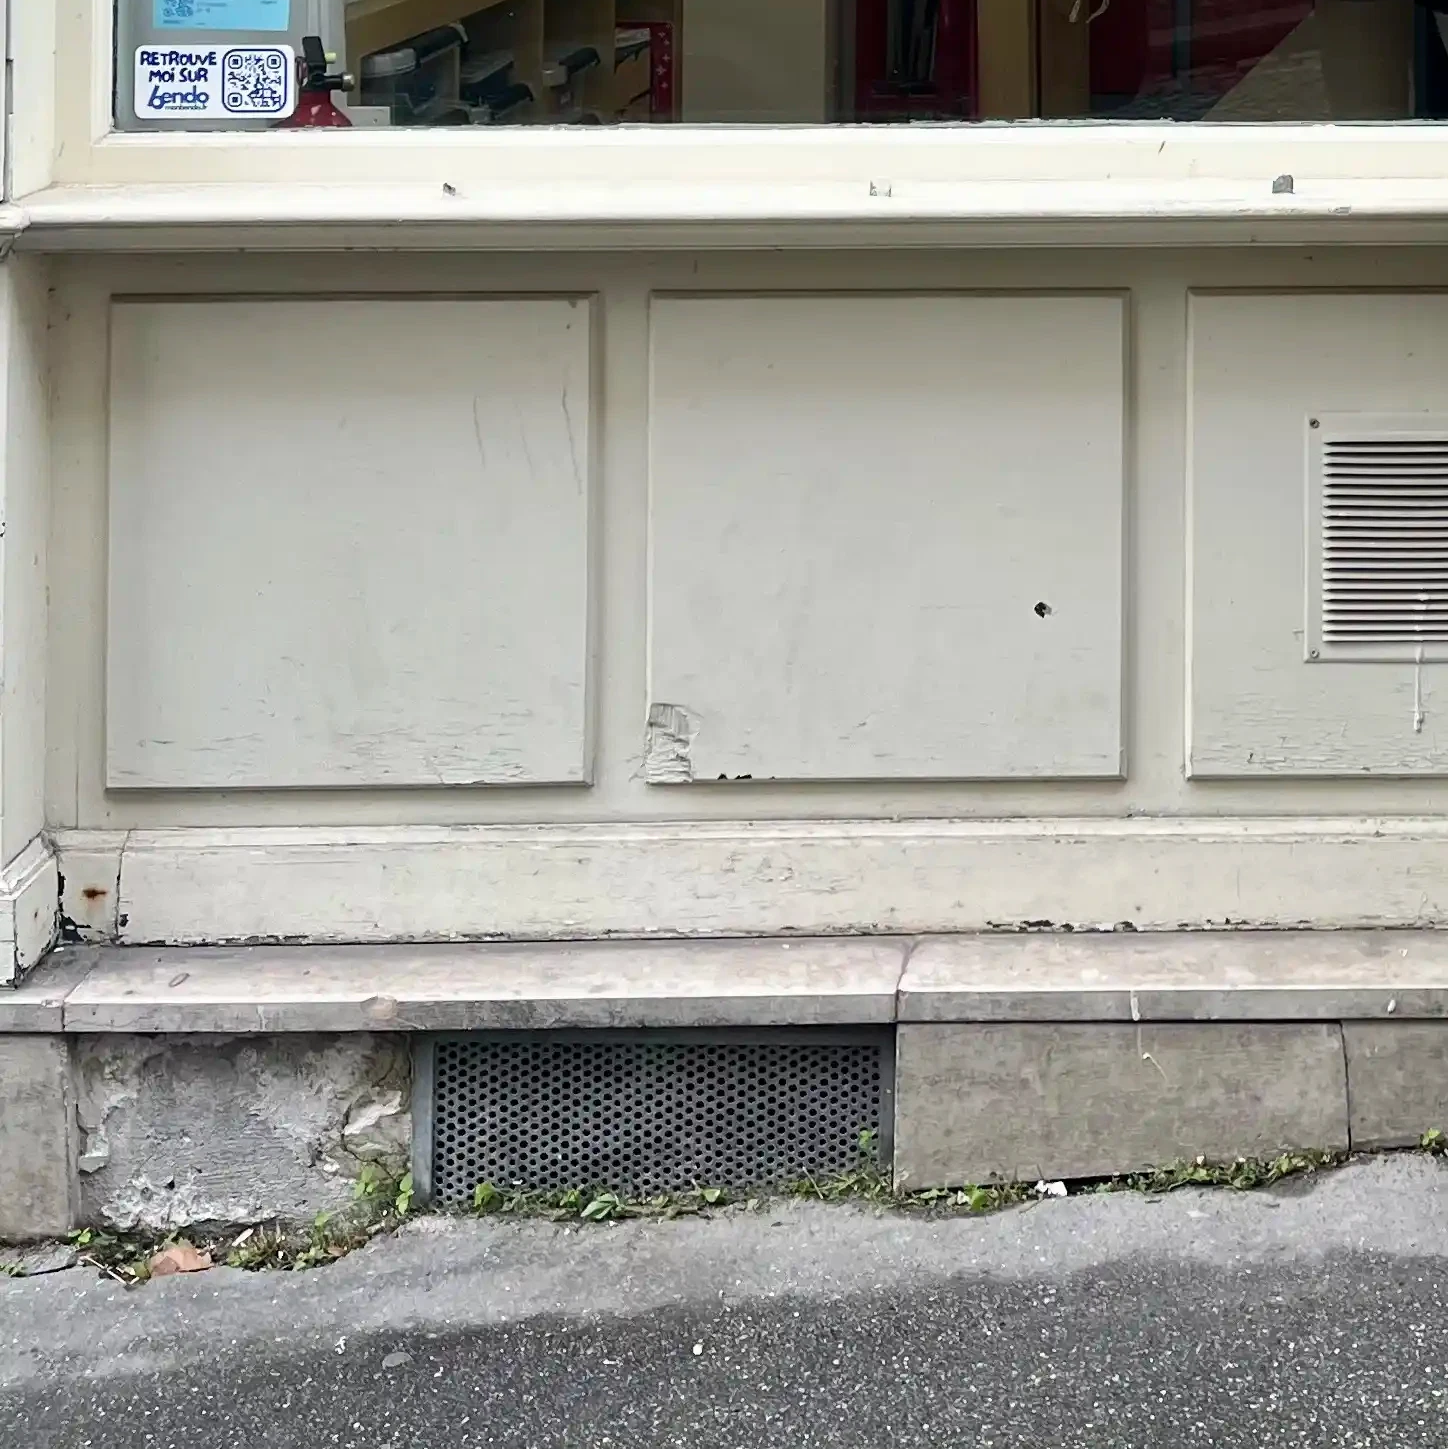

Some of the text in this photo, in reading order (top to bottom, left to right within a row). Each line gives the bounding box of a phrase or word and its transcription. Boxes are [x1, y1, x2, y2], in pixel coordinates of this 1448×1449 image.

[140, 50, 217, 66] RETROUVE
[179, 67, 209, 83] SUR
[147, 85, 210, 110] bendo
